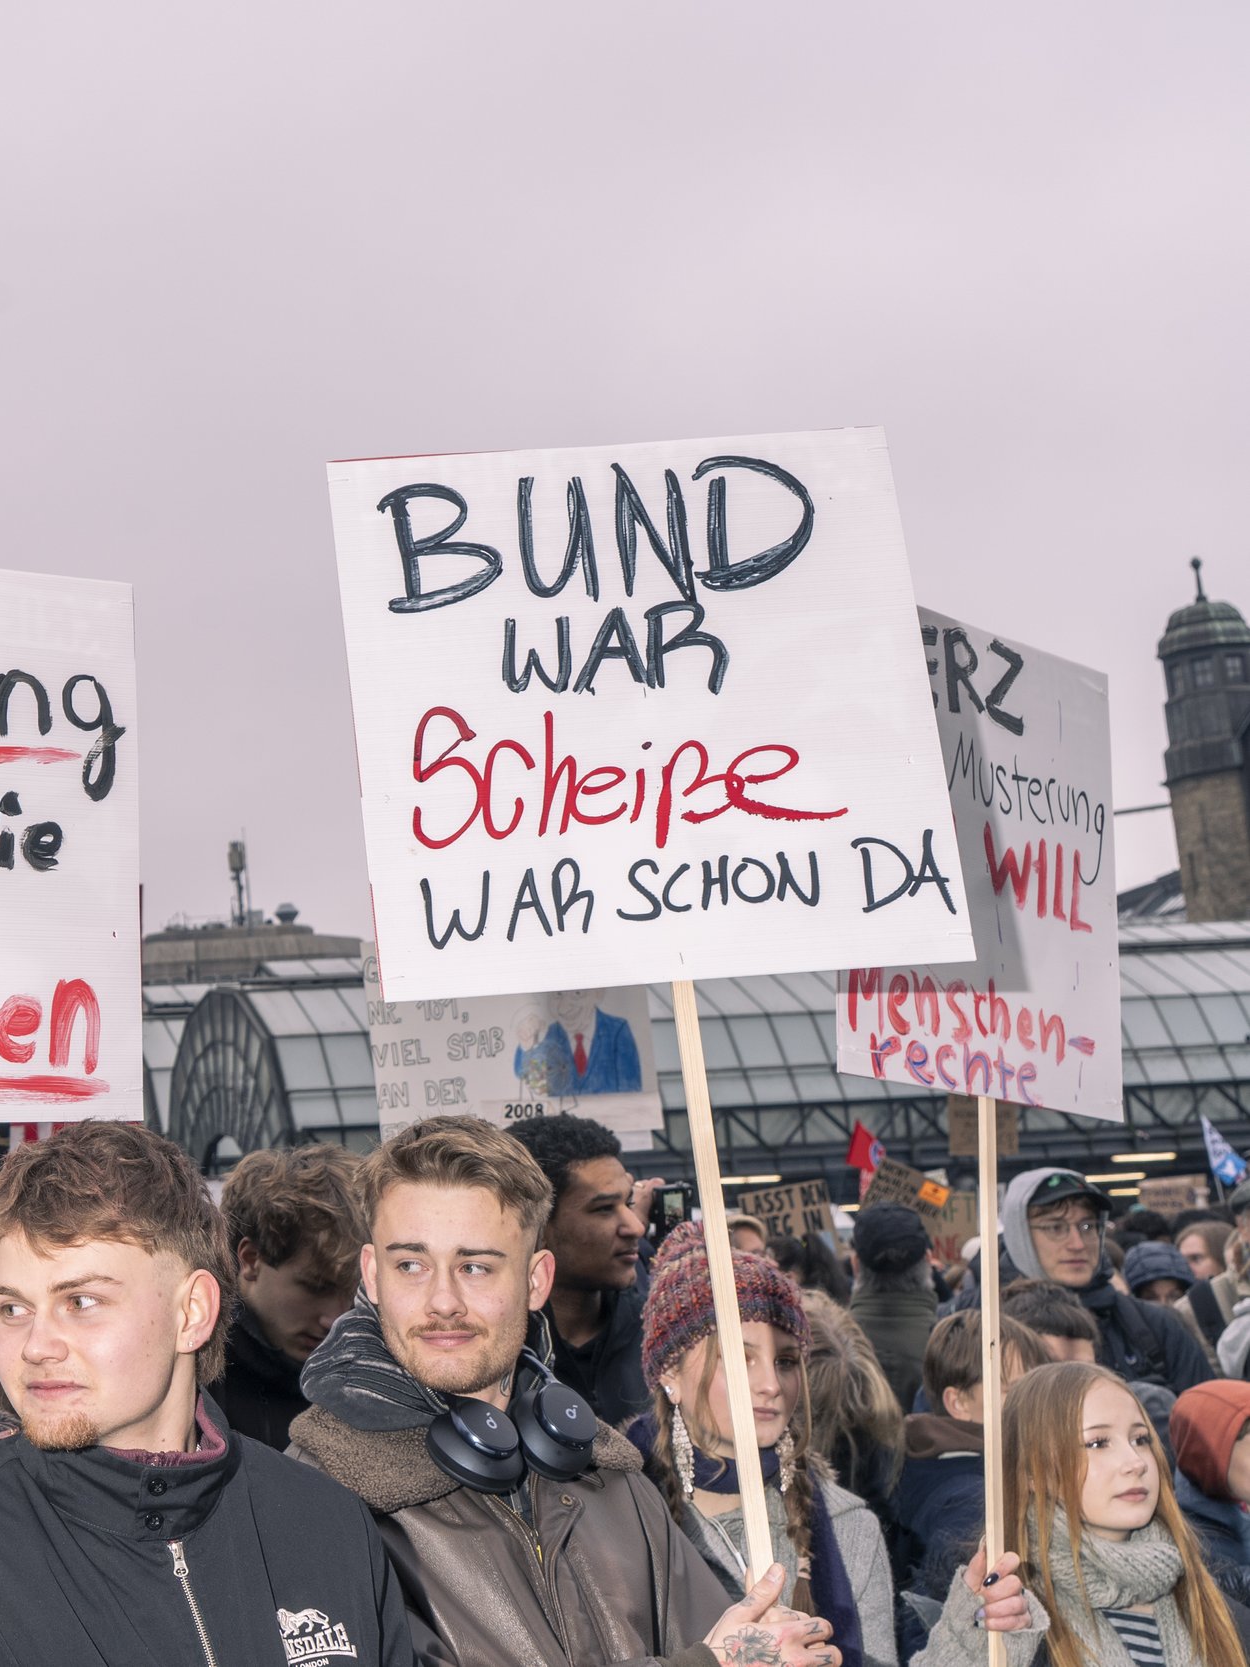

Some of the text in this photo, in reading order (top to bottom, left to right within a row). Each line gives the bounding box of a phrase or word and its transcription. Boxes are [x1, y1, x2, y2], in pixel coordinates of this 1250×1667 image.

[377, 456, 814, 612] BUND
[502, 601, 731, 696] WAR
[920, 625, 1024, 736] ERZ
[412, 706, 850, 850] Scheiße
[948, 731, 1106, 887] Musterung
[420, 828, 958, 951] WAR SCHON DA
[984, 821, 1093, 934] WILL
[373, 1038, 431, 1067] VIEL
[848, 967, 1096, 1066] Menschen-
[377, 1076, 468, 1109] AN DER
[504, 1104, 544, 1119] 2008
[870, 1033, 1043, 1107] rechte
[741, 1188, 795, 1216] LASST
[803, 1208, 825, 1231] IN
[282, 1622, 352, 1659] NSDALE
